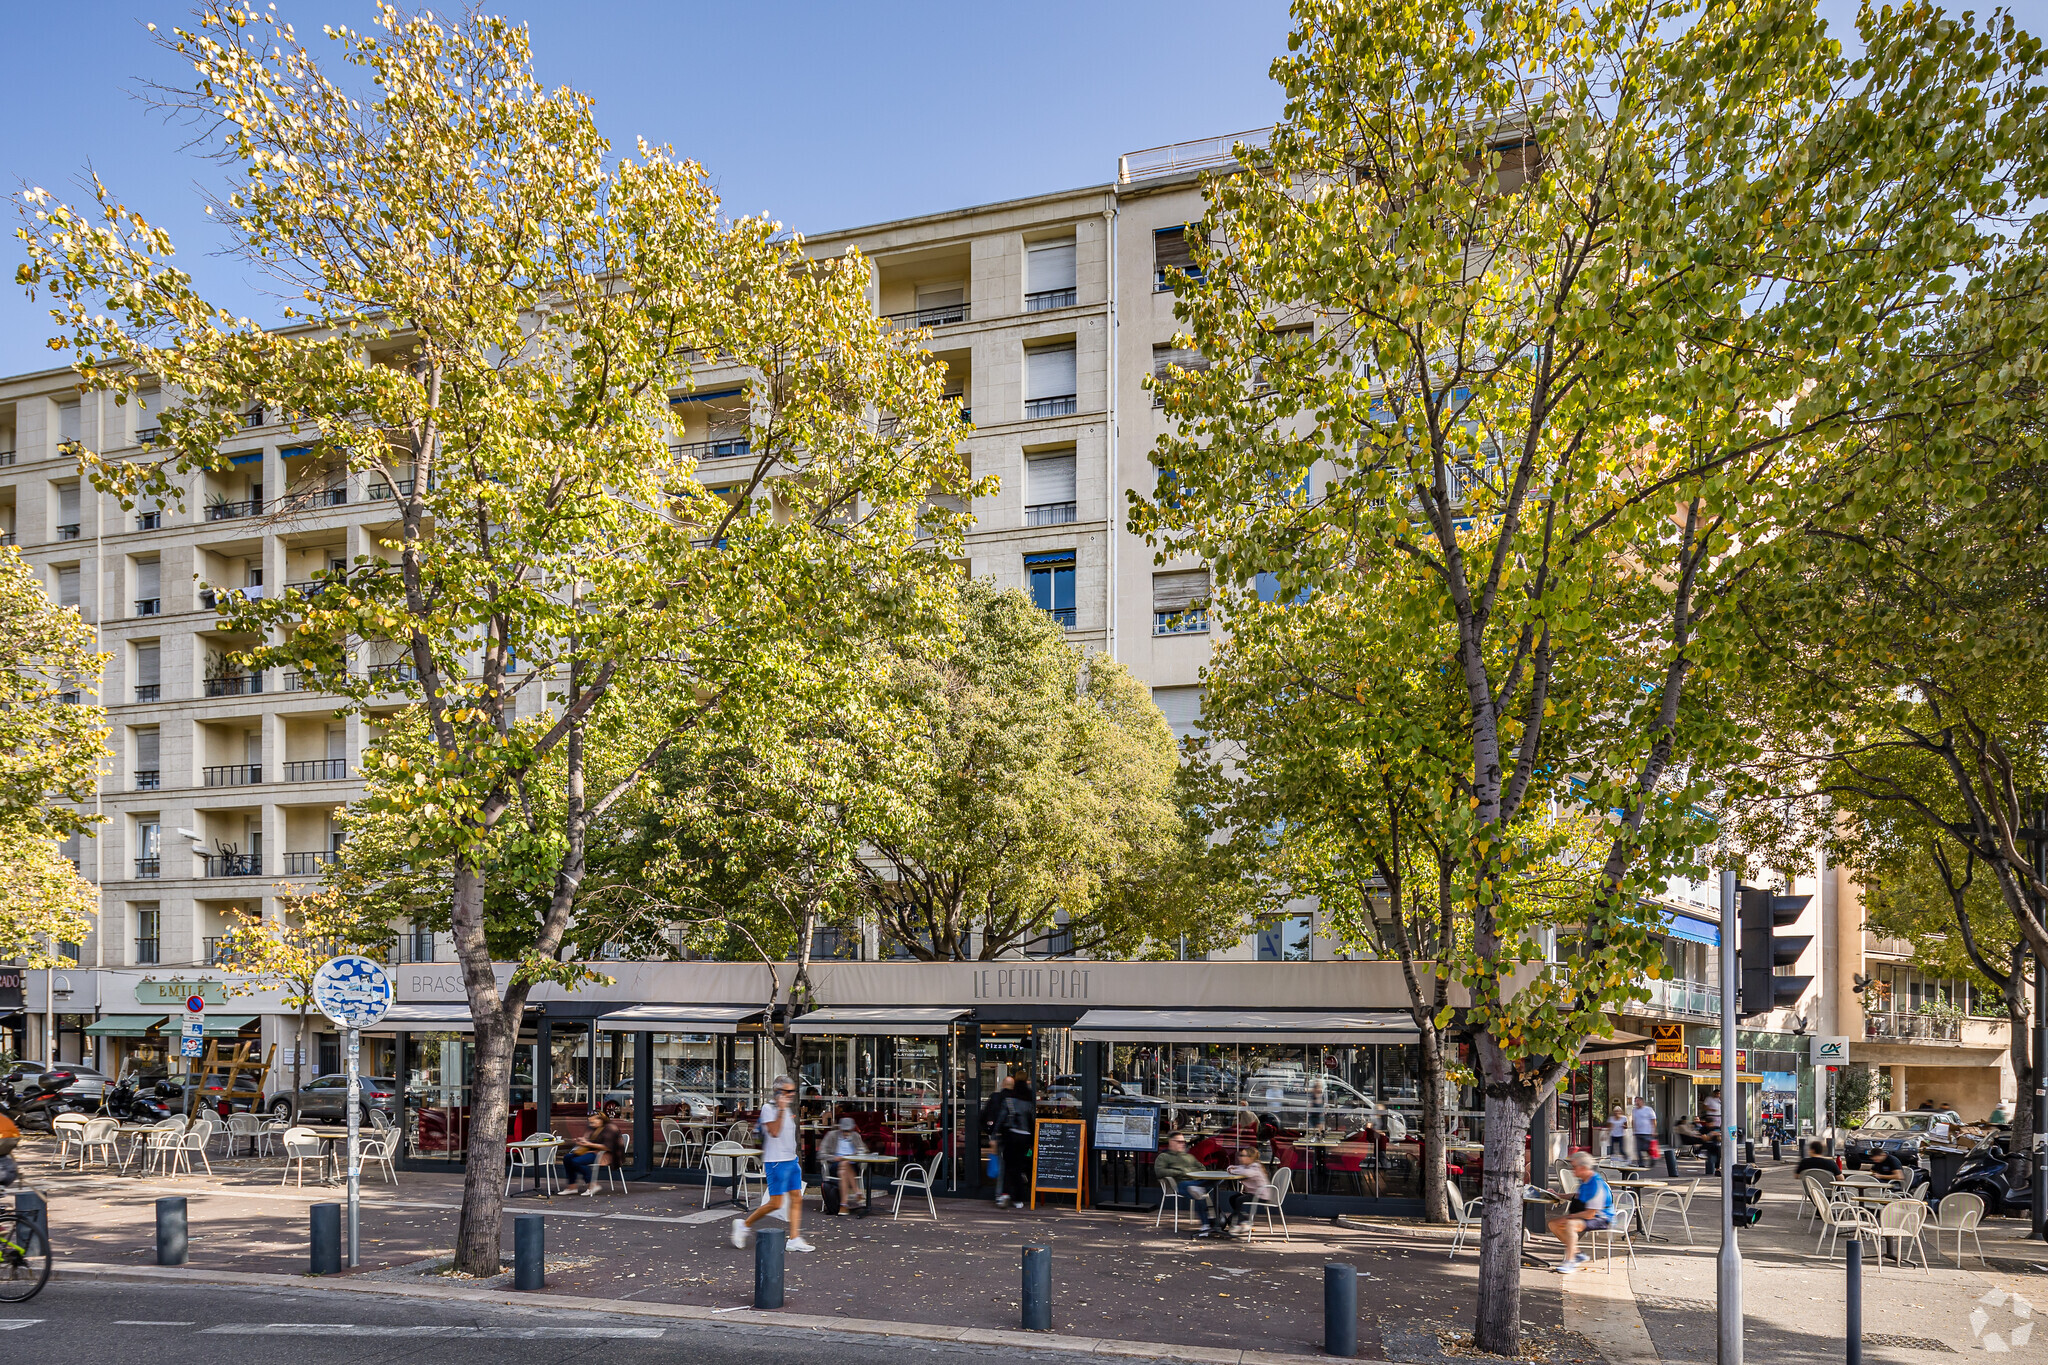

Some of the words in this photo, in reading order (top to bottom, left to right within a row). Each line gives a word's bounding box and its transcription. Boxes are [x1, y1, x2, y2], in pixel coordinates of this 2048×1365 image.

[159, 985, 205, 997] EMILE
[974, 970, 990, 998] LE
[998, 969, 1042, 997] PETIT
[1049, 969, 1091, 998] PLAT
